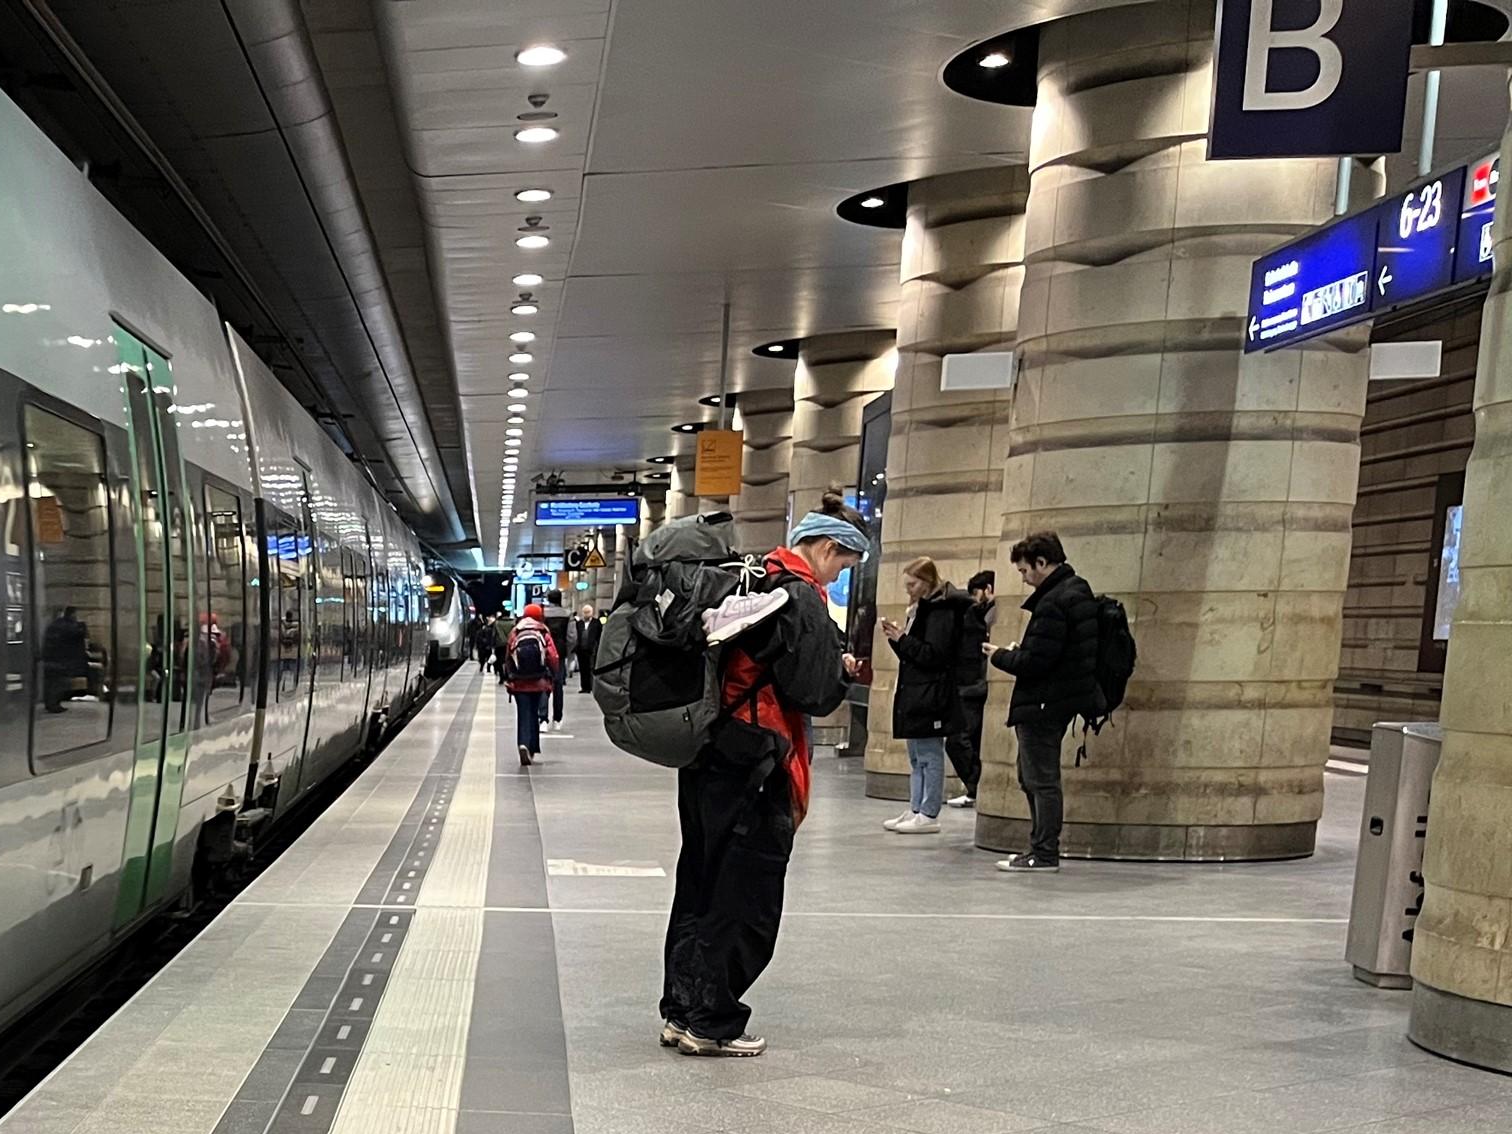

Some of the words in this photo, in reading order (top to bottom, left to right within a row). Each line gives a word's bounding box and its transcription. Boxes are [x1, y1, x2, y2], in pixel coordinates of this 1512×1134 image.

[1243, 0, 1343, 111] B
[1399, 180, 1442, 239] 6-23
[568, 550, 581, 567] C
